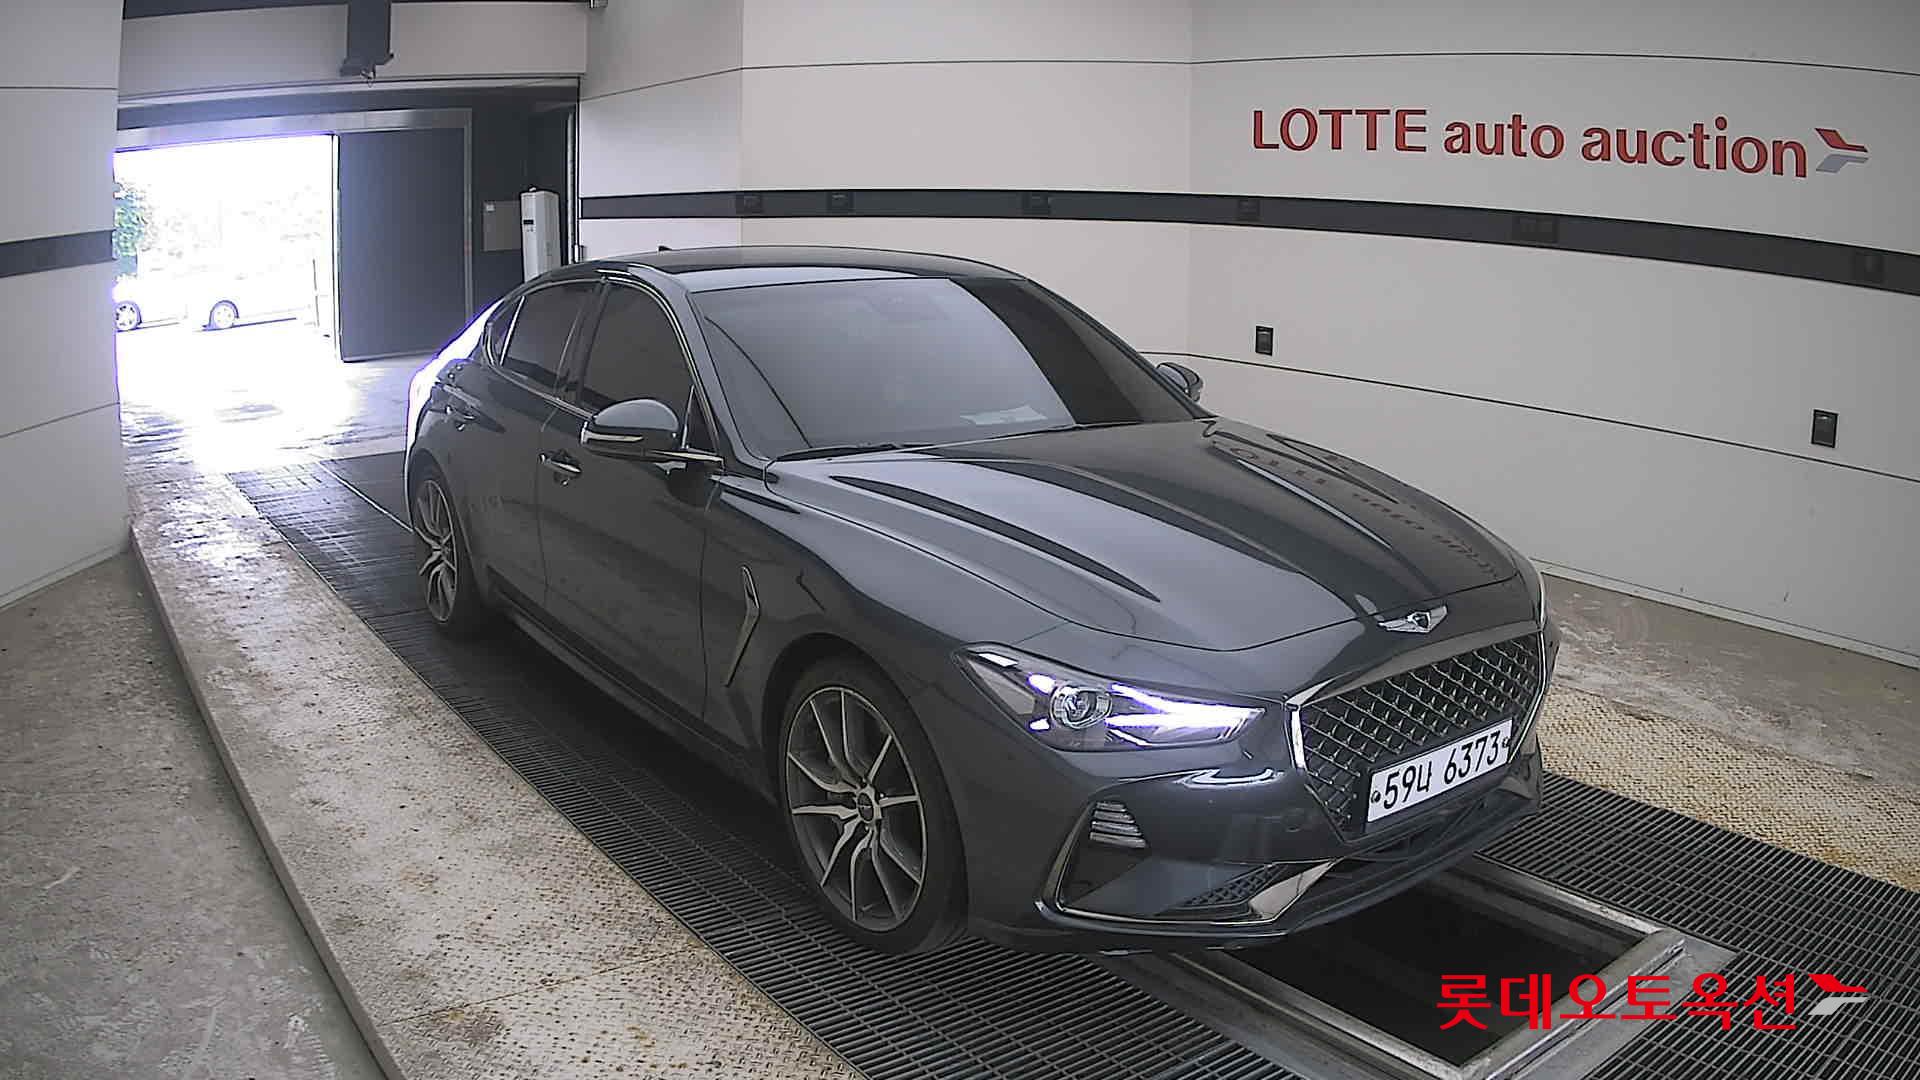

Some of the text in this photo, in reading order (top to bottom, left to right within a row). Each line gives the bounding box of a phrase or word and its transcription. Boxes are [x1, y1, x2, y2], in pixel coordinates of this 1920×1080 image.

[1252, 107, 1808, 177] LOTTE auto auction
[1443, 731, 1501, 783] 6373
